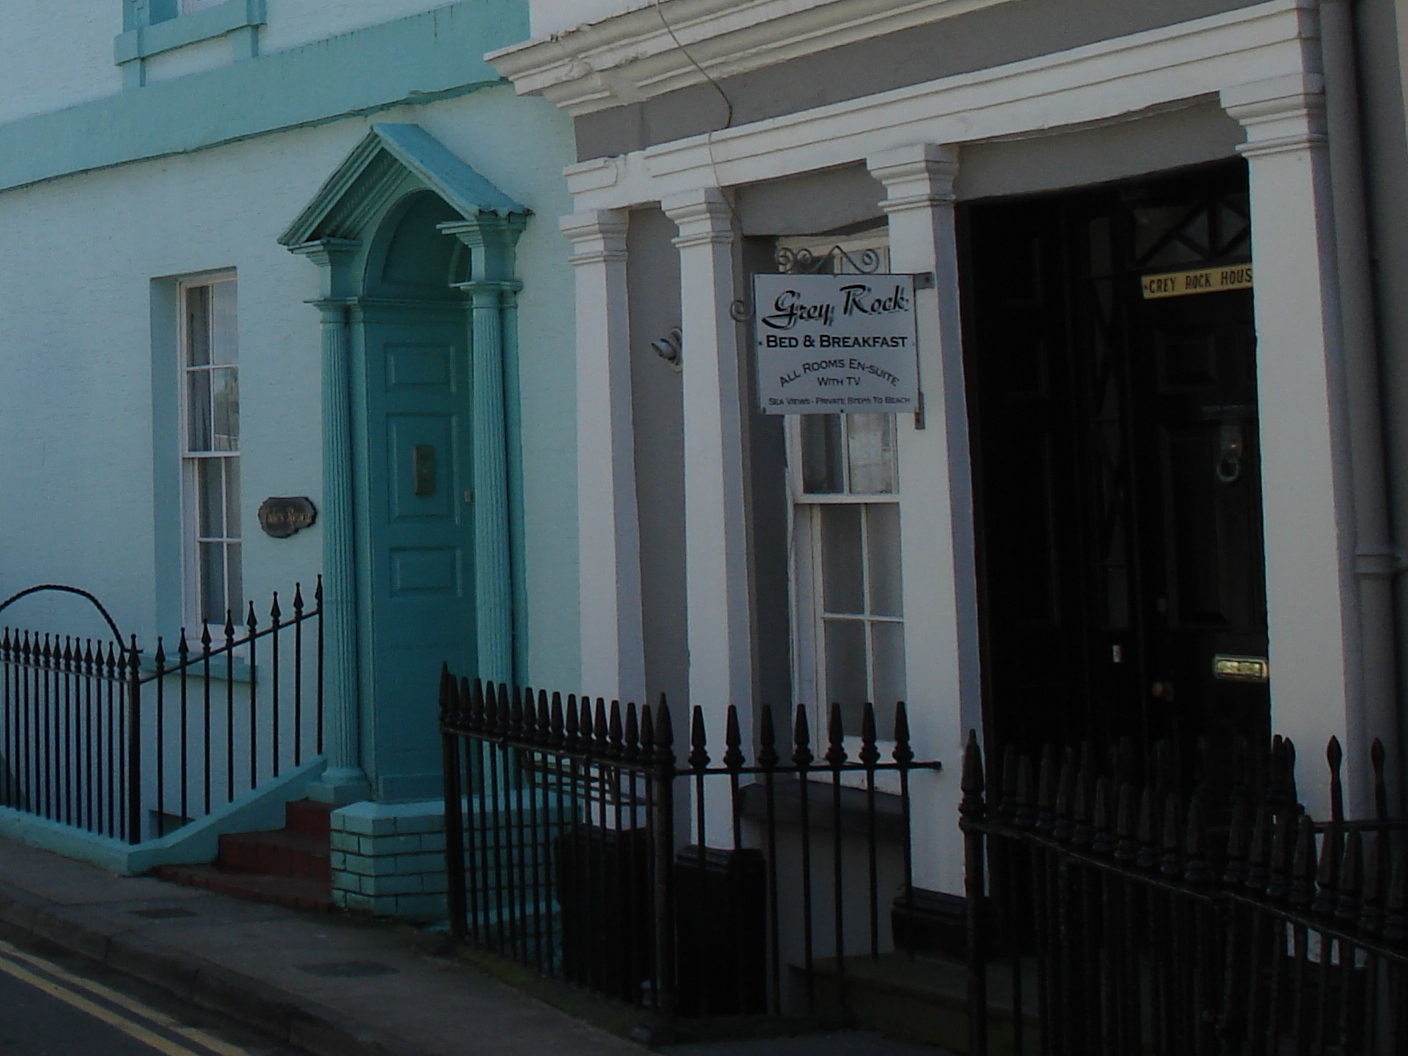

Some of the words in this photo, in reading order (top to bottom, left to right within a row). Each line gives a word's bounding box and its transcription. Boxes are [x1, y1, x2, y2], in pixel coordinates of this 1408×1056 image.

[1185, 274, 1211, 290] ROCK
[1220, 268, 1252, 286] HOUS
[761, 290, 834, 330] Grey
[839, 284, 909, 316] Rock
[766, 335, 798, 348] BED
[803, 335, 815, 348] &
[819, 335, 908, 348] BREAKFAST
[779, 370, 801, 387] ALL
[802, 359, 845, 374] ROOMS
[846, 377, 861, 386] TV
